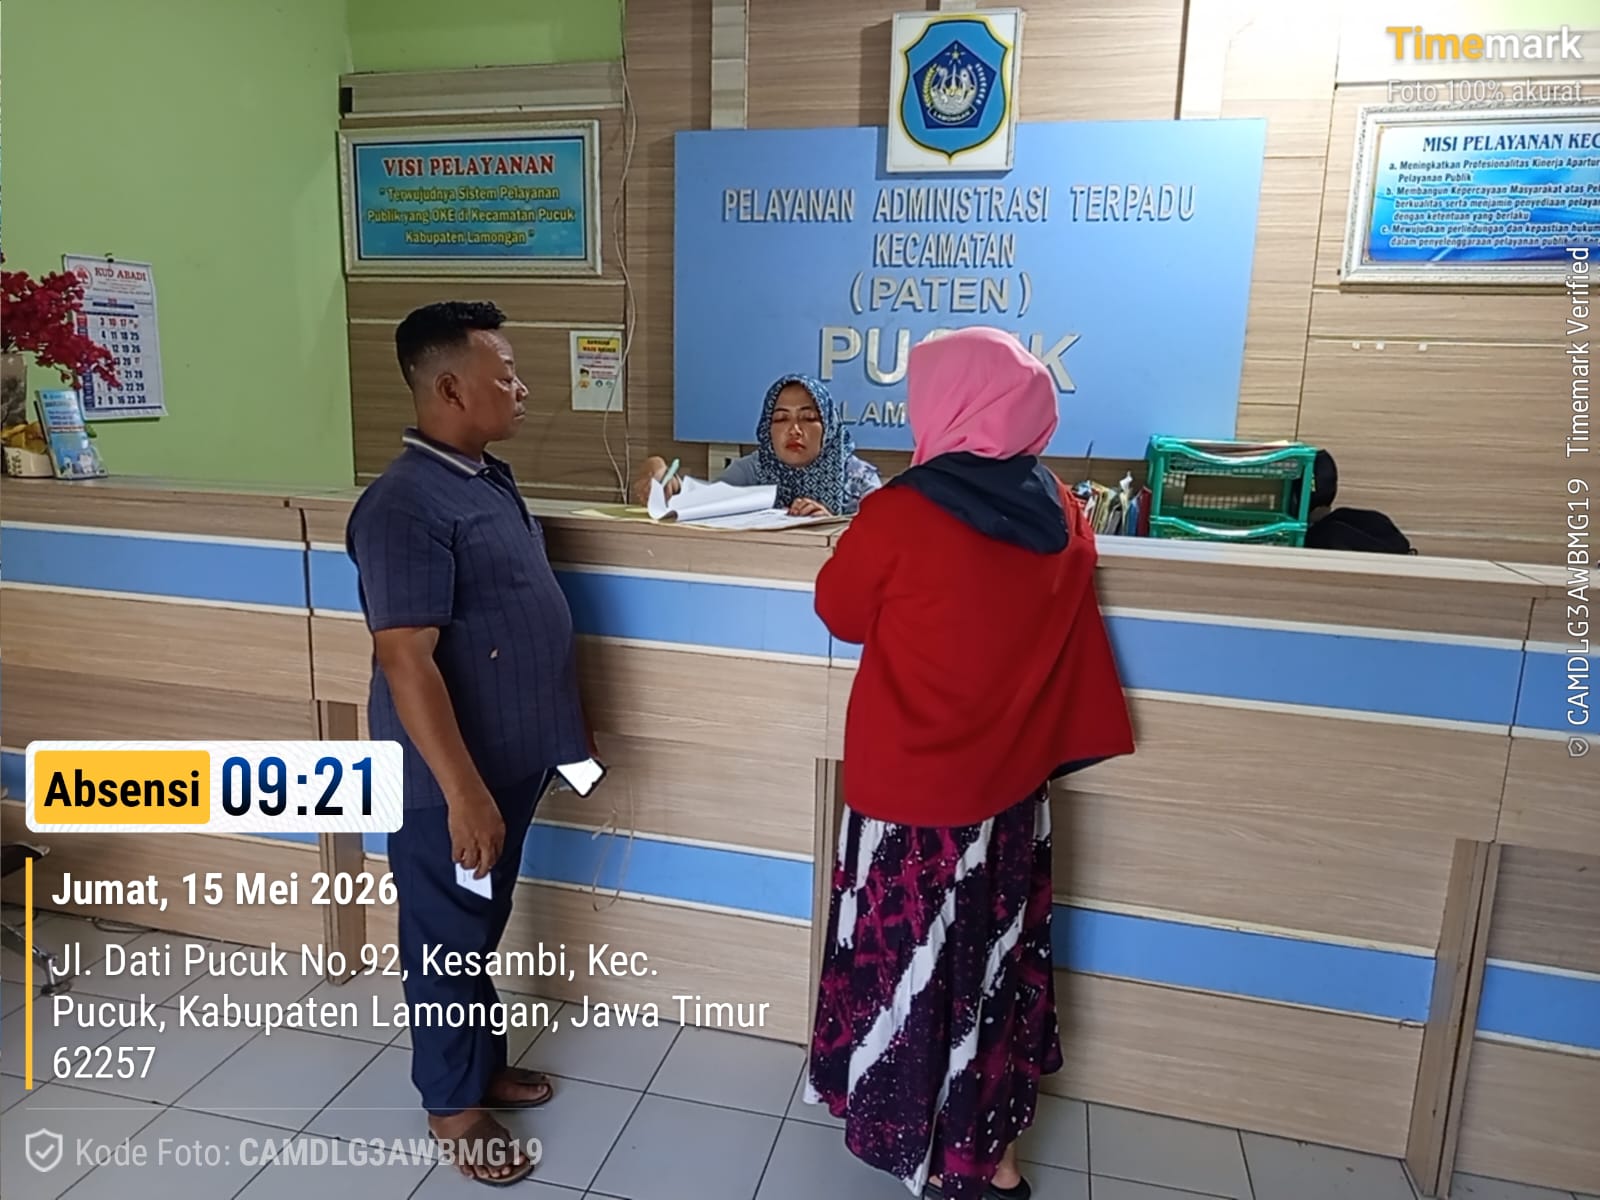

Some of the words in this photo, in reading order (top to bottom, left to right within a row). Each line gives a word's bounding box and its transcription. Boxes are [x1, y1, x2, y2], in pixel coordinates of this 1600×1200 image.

[1423, 136, 1457, 152] MISI
[1463, 134, 1563, 150] PELAYANAN
[384, 158, 423, 176] VISI
[430, 155, 554, 176] PELAYANAN
[1400, 160, 1460, 172] Meningkatkan
[1463, 158, 1529, 169] Profesionalitas
[1532, 158, 1563, 169] Kinerja
[1398, 173, 1442, 184] Pelayanan
[1445, 172, 1472, 182] Publik
[388, 188, 456, 204] Terwujudnya
[458, 187, 497, 200] Sistem
[500, 187, 560, 203] Pelayanan
[1397, 186, 1448, 198] Membangun
[1451, 186, 1507, 197] Kepercayaan
[1510, 184, 1562, 195] Masyarakat
[1565, 186, 1584, 194] atas
[723, 189, 856, 222] PELAYANAN
[873, 187, 1048, 222] ADMINISTRASI
[1071, 184, 1195, 221] TERPADU
[1395, 200, 1442, 208] berkualitas
[1445, 200, 1467, 208] serta
[1470, 199, 1512, 210] menjamin
[1514, 198, 1566, 210] penyediaan
[368, 210, 401, 222] Publik
[404, 212, 430, 225] yang
[432, 210, 455, 222] OKE
[458, 210, 469, 222] di
[471, 209, 535, 222] Kecamatan
[538, 208, 576, 222] Pucuk
[1394, 212, 1424, 222] dengan
[1427, 212, 1470, 220] ketentuan
[1472, 212, 1494, 222] yang
[1496, 212, 1530, 220] berlaku
[1392, 224, 1446, 235] Mewujudkan
[1447, 224, 1504, 235] perlindungan
[1506, 224, 1523, 233] dan
[1526, 224, 1568, 235] kepastian
[405, 231, 465, 246] Kabupaten
[468, 231, 526, 246] Lamongan
[1391, 237, 1416, 246] dalam
[1494, 237, 1540, 248] pelayanan
[873, 233, 1015, 268] KECAMATAN
[95, 267, 114, 277] KUD
[117, 270, 146, 281] ABADI
[820, 326, 1081, 393] PUK
